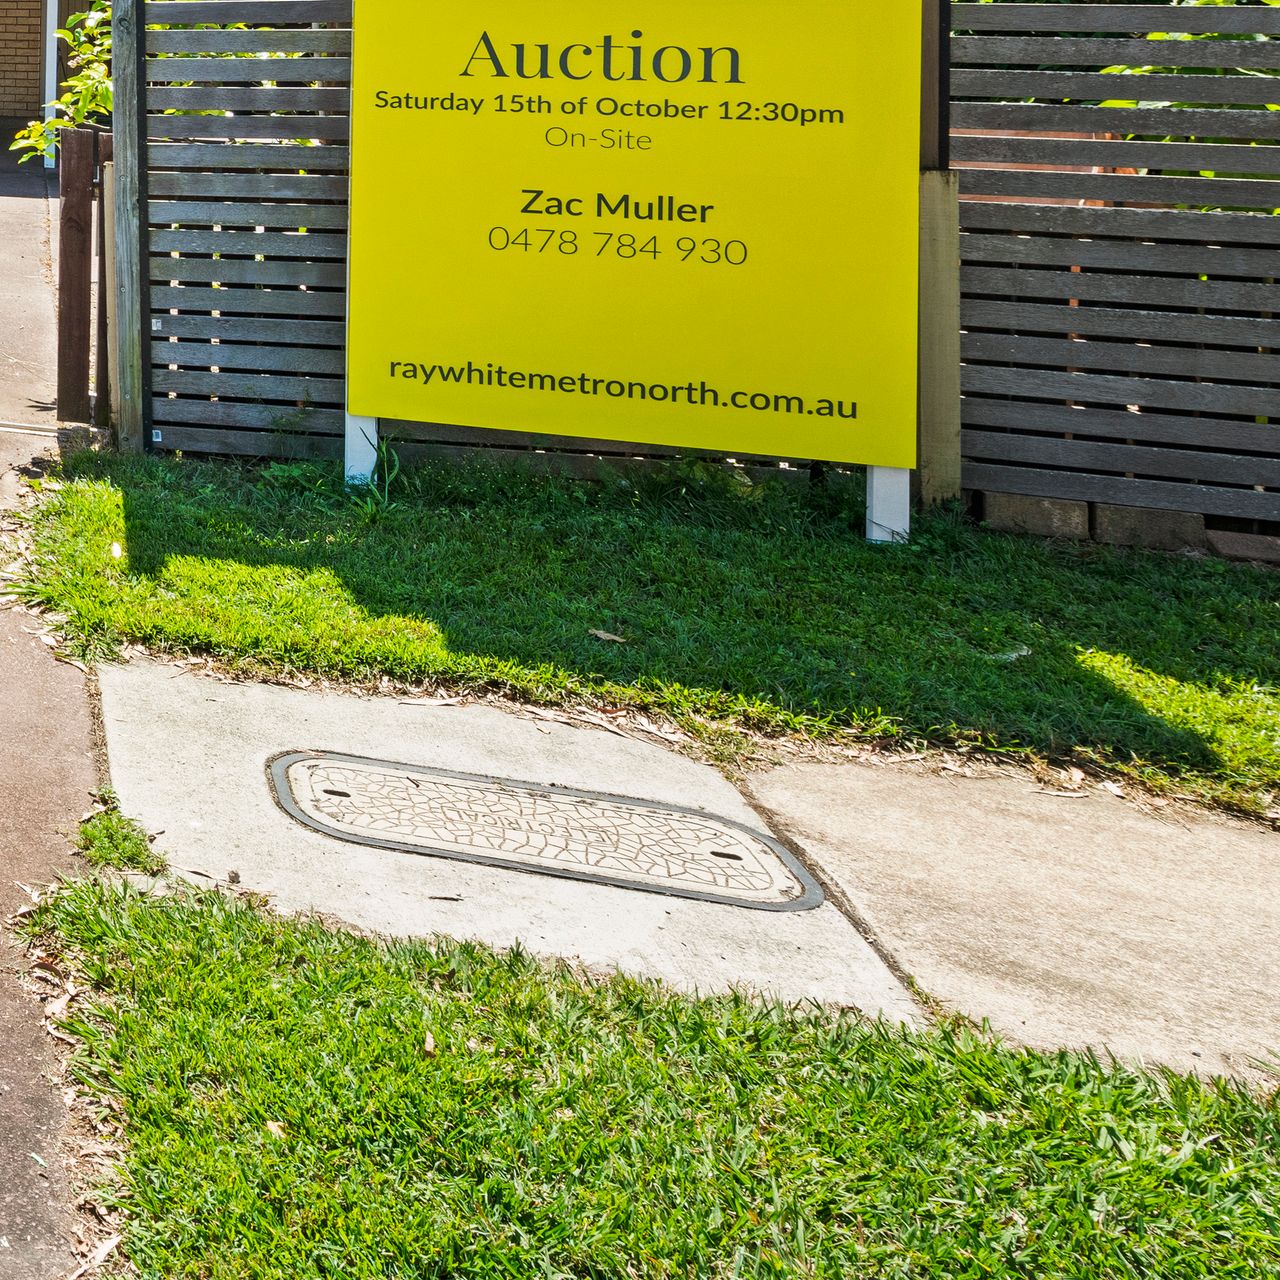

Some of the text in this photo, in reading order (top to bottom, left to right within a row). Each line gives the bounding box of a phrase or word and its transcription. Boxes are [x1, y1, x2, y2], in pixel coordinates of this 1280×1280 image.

[458, 30, 746, 84] Auction
[374, 90, 844, 127] Saturday 15th of October 12:30pm
[544, 126, 652, 151] On-Site
[520, 189, 715, 224] Zac Muller
[488, 226, 748, 266] 0478 784 930
[390, 361, 858, 420] raywhitemetronorth.com.au
[446, 808, 607, 844] ELECTRICAL
